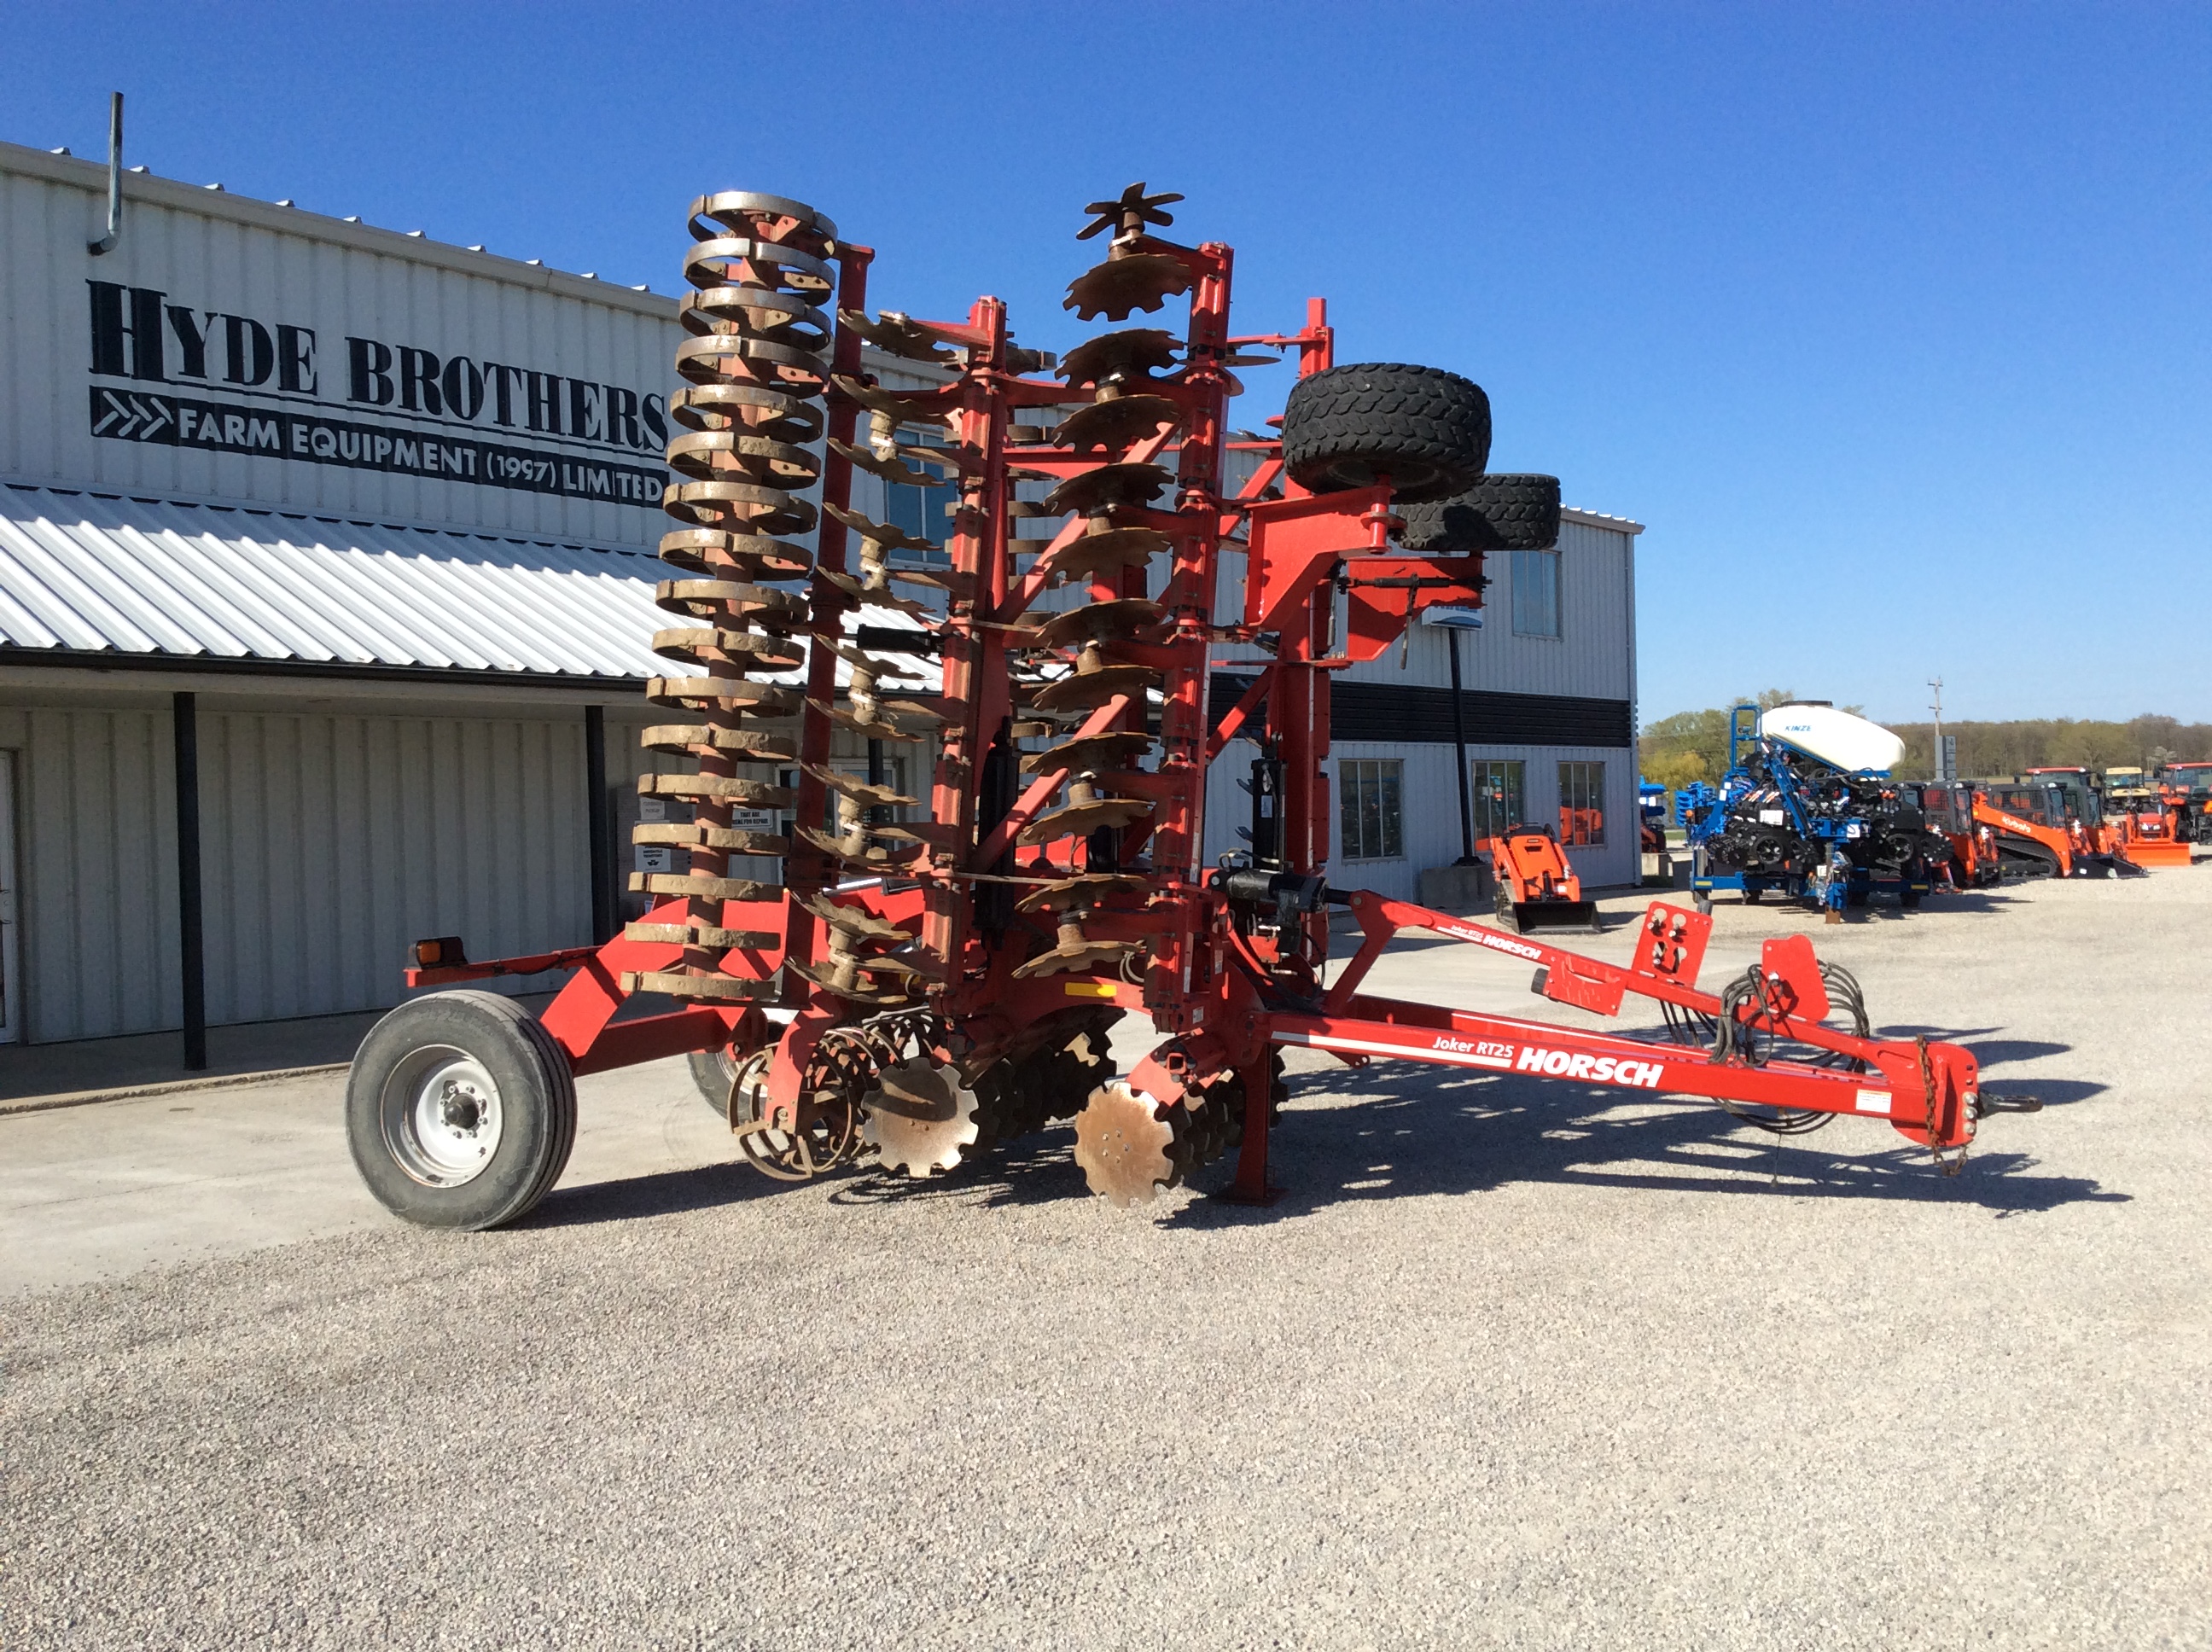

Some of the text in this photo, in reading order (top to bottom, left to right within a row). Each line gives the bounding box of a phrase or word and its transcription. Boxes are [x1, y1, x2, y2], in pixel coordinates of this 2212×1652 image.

[85, 279, 668, 452] HYDE BROTHERS
[179, 409, 663, 502] FARM EQUIPMENT (1997) LIMITED
[1451, 925, 1468, 934] Joker
[1482, 934, 1542, 959] HORSCH
[1432, 1036, 1664, 1088] Joker RT25 HORSCH
